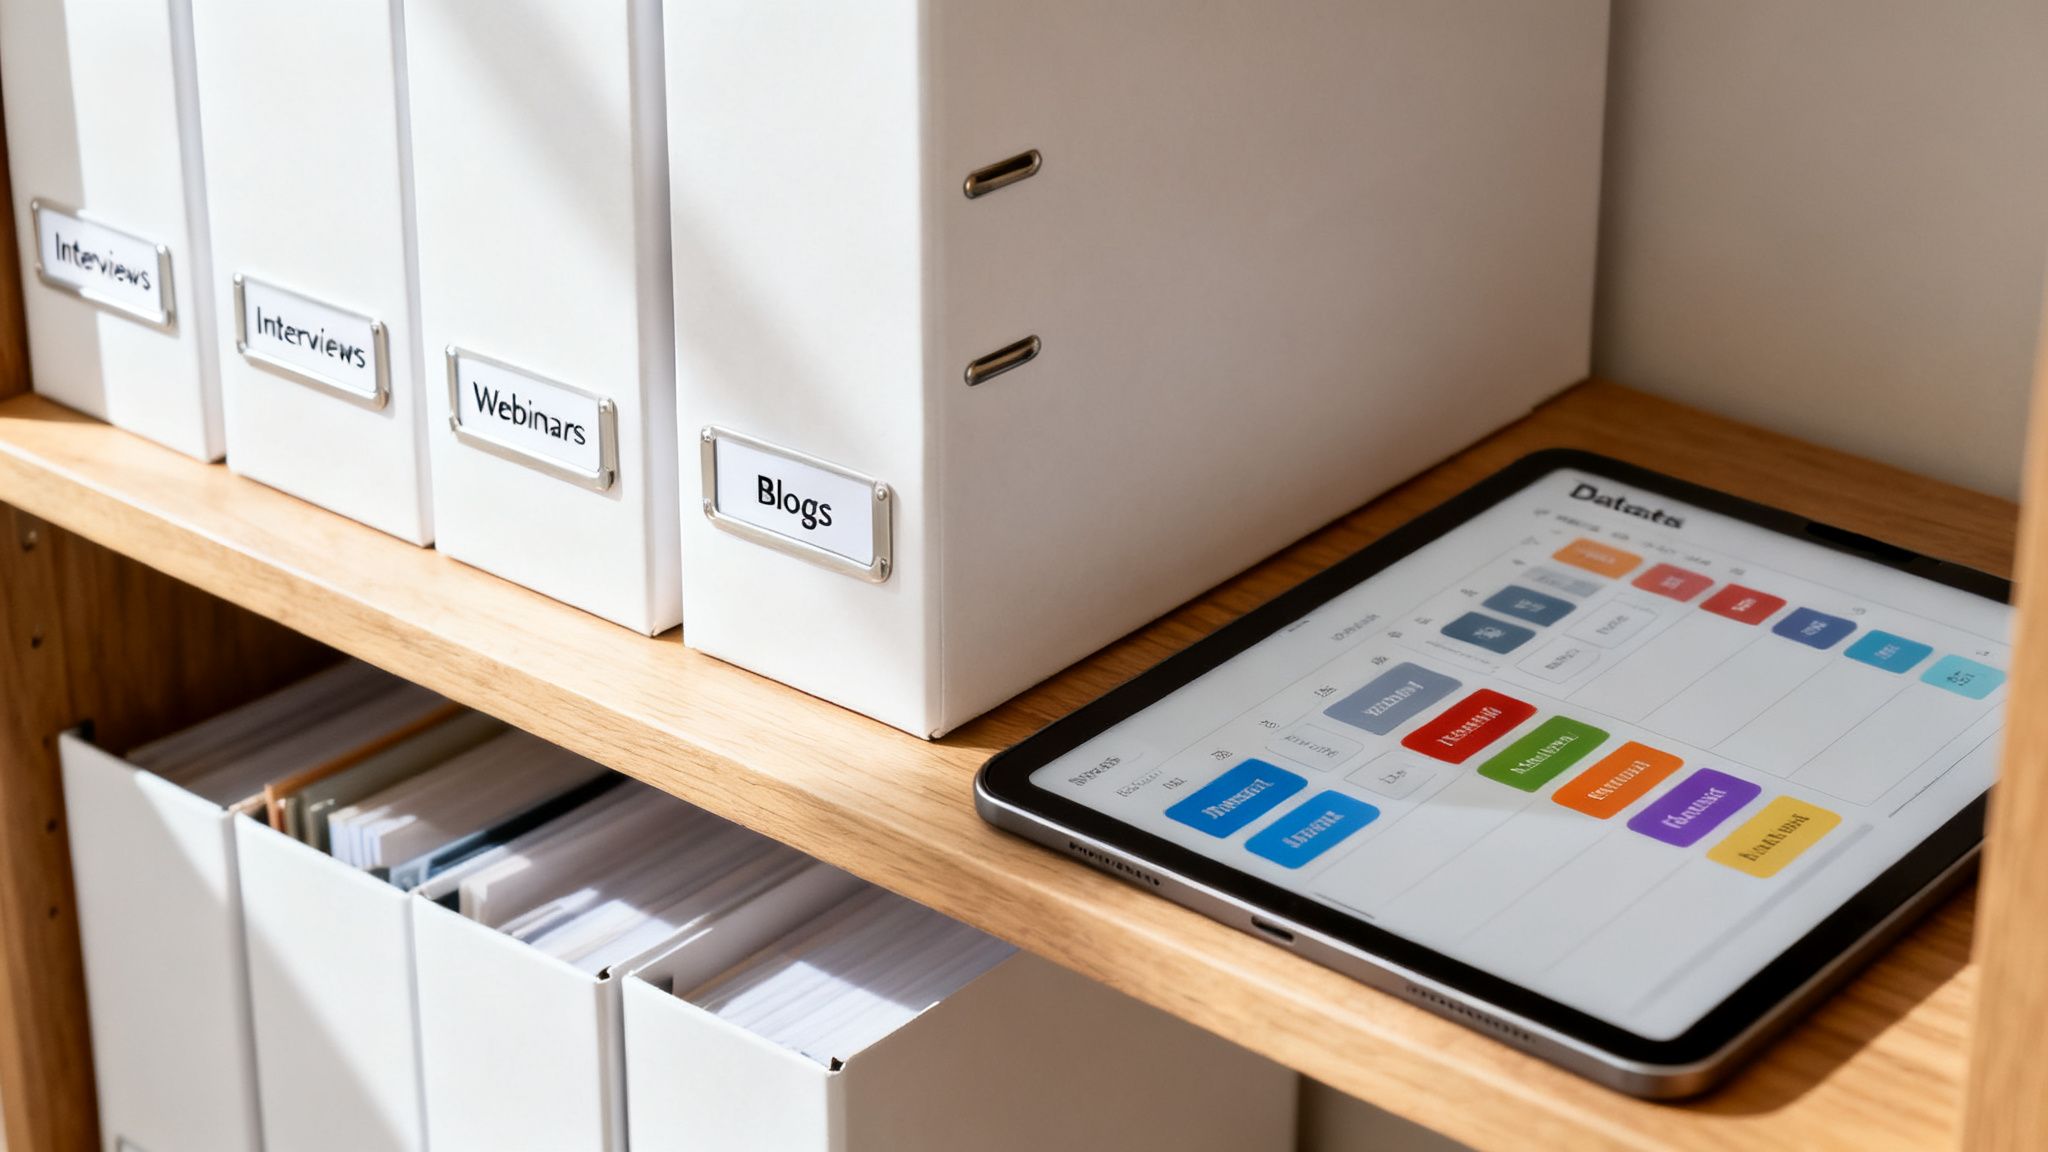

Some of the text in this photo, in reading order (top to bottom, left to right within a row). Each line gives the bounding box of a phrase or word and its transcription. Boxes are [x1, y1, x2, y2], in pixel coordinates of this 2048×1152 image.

[55, 232, 151, 290] Interviews
[257, 306, 366, 368] Interviews
[473, 381, 586, 446] Webinars
[757, 474, 833, 530] Blogs
